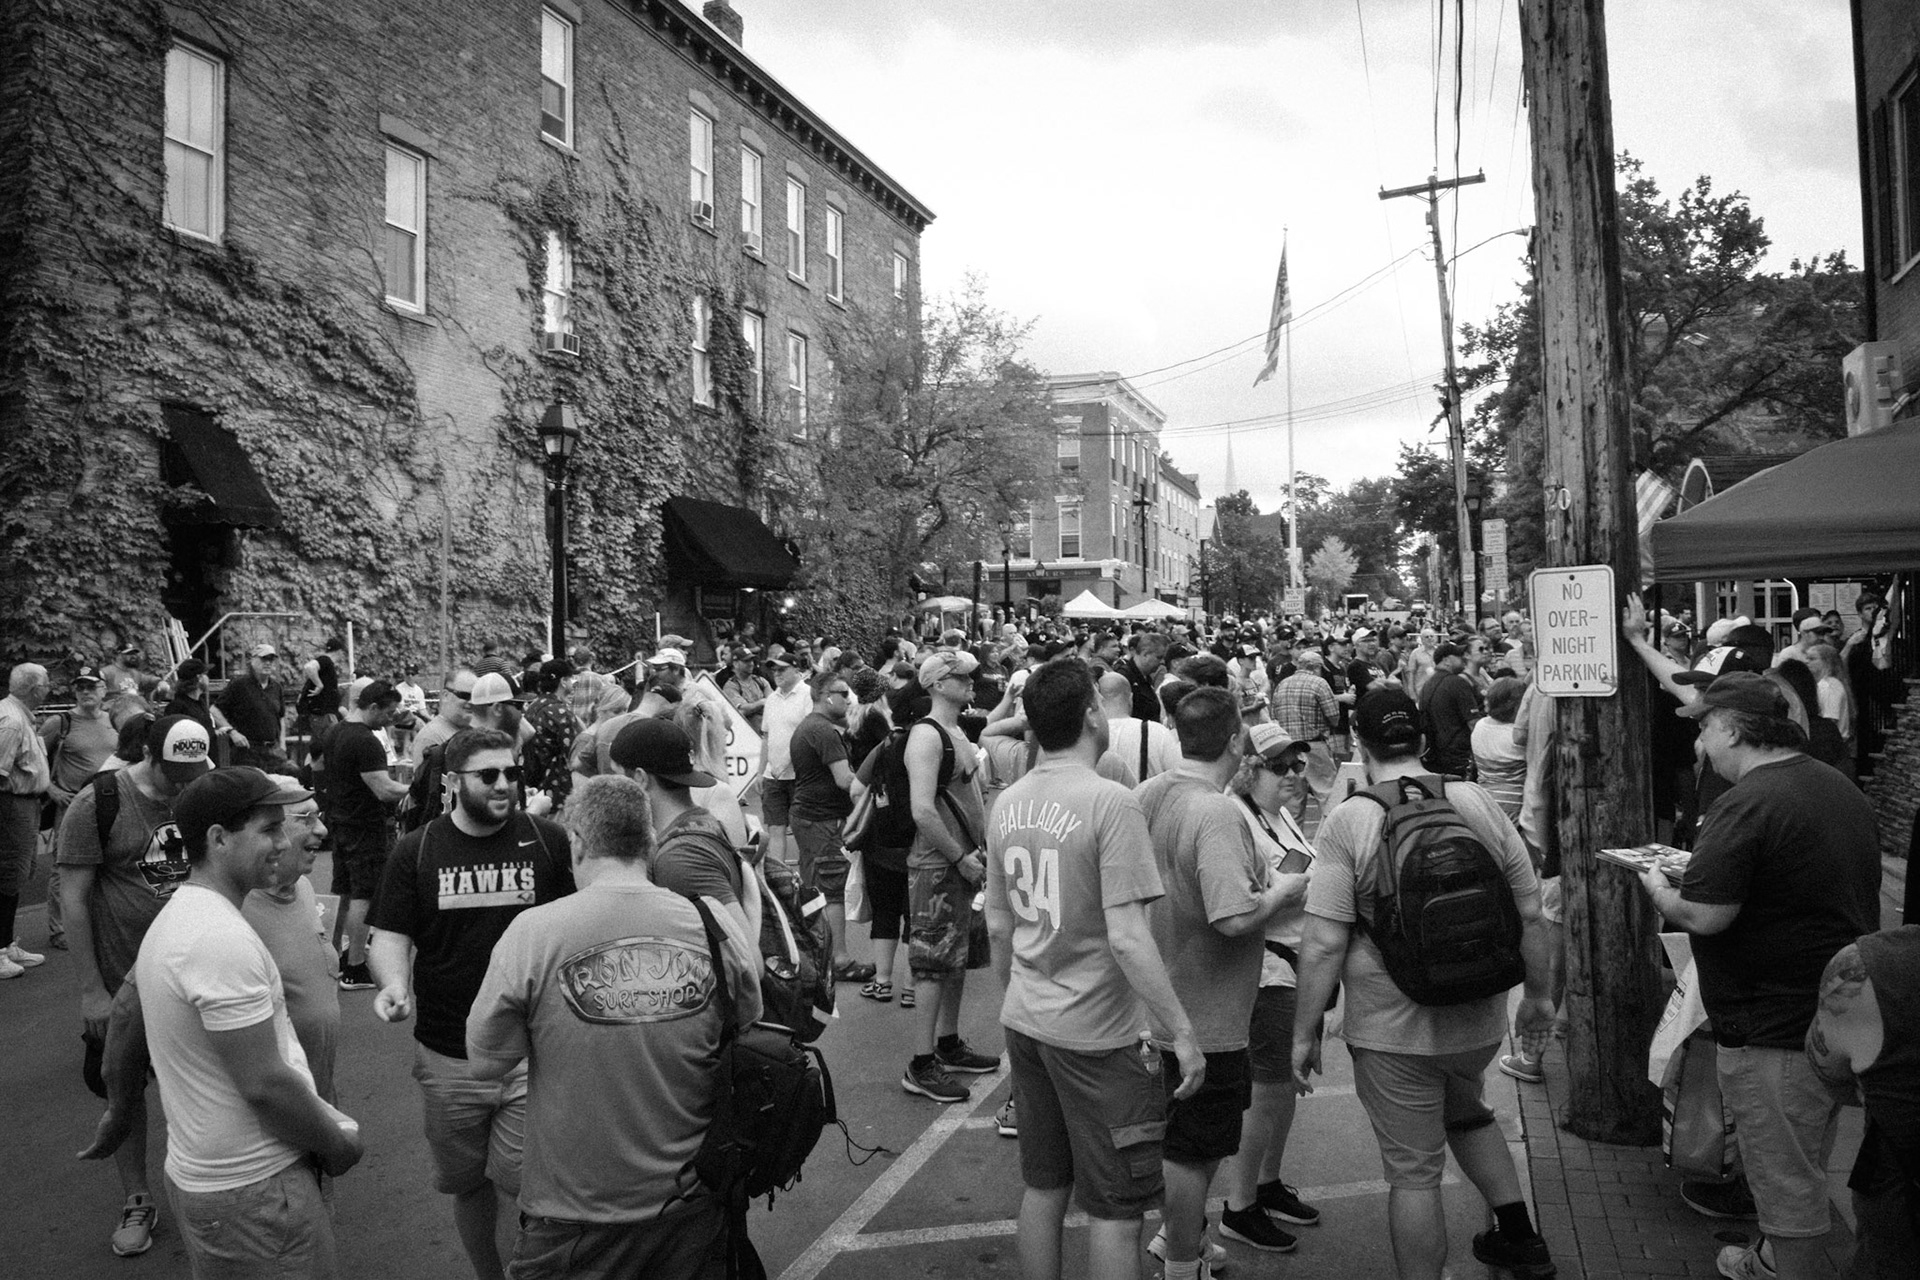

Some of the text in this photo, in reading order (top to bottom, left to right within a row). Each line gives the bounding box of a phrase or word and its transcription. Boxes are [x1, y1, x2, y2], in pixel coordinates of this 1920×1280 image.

[1562, 583, 1583, 600] NO
[1548, 609, 1599, 628] OVER-
[1552, 636, 1597, 655] NIGHT
[1543, 663, 1608, 682] PARKING
[998, 799, 1082, 843] HALLADAY
[438, 867, 535, 896] HAWKS
[1004, 845, 1061, 930] 34
[572, 947, 712, 997] RON JON
[593, 985, 697, 1011] SURF SHOP
